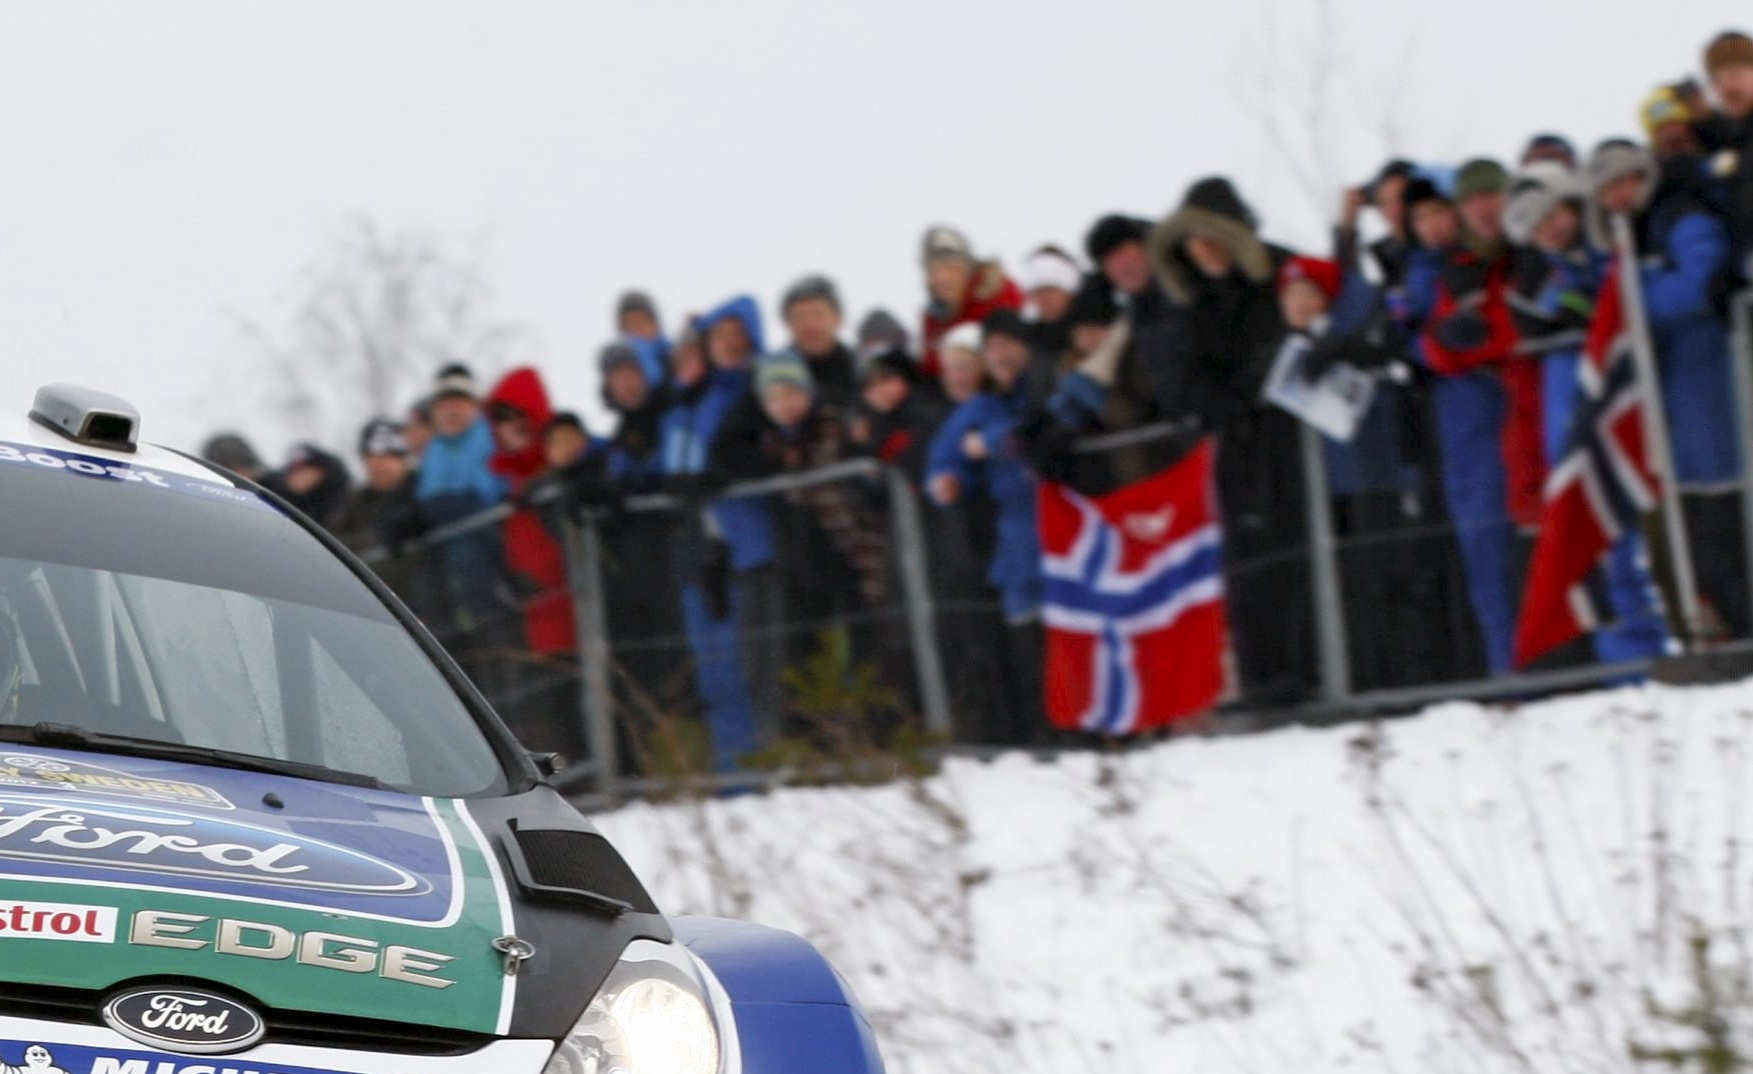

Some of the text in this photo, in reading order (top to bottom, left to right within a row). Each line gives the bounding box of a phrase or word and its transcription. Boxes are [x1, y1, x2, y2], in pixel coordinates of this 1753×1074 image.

[39, 769, 206, 798] SWEDEN
[128, 909, 458, 990] EDGE
[140, 994, 230, 1038] Ford
